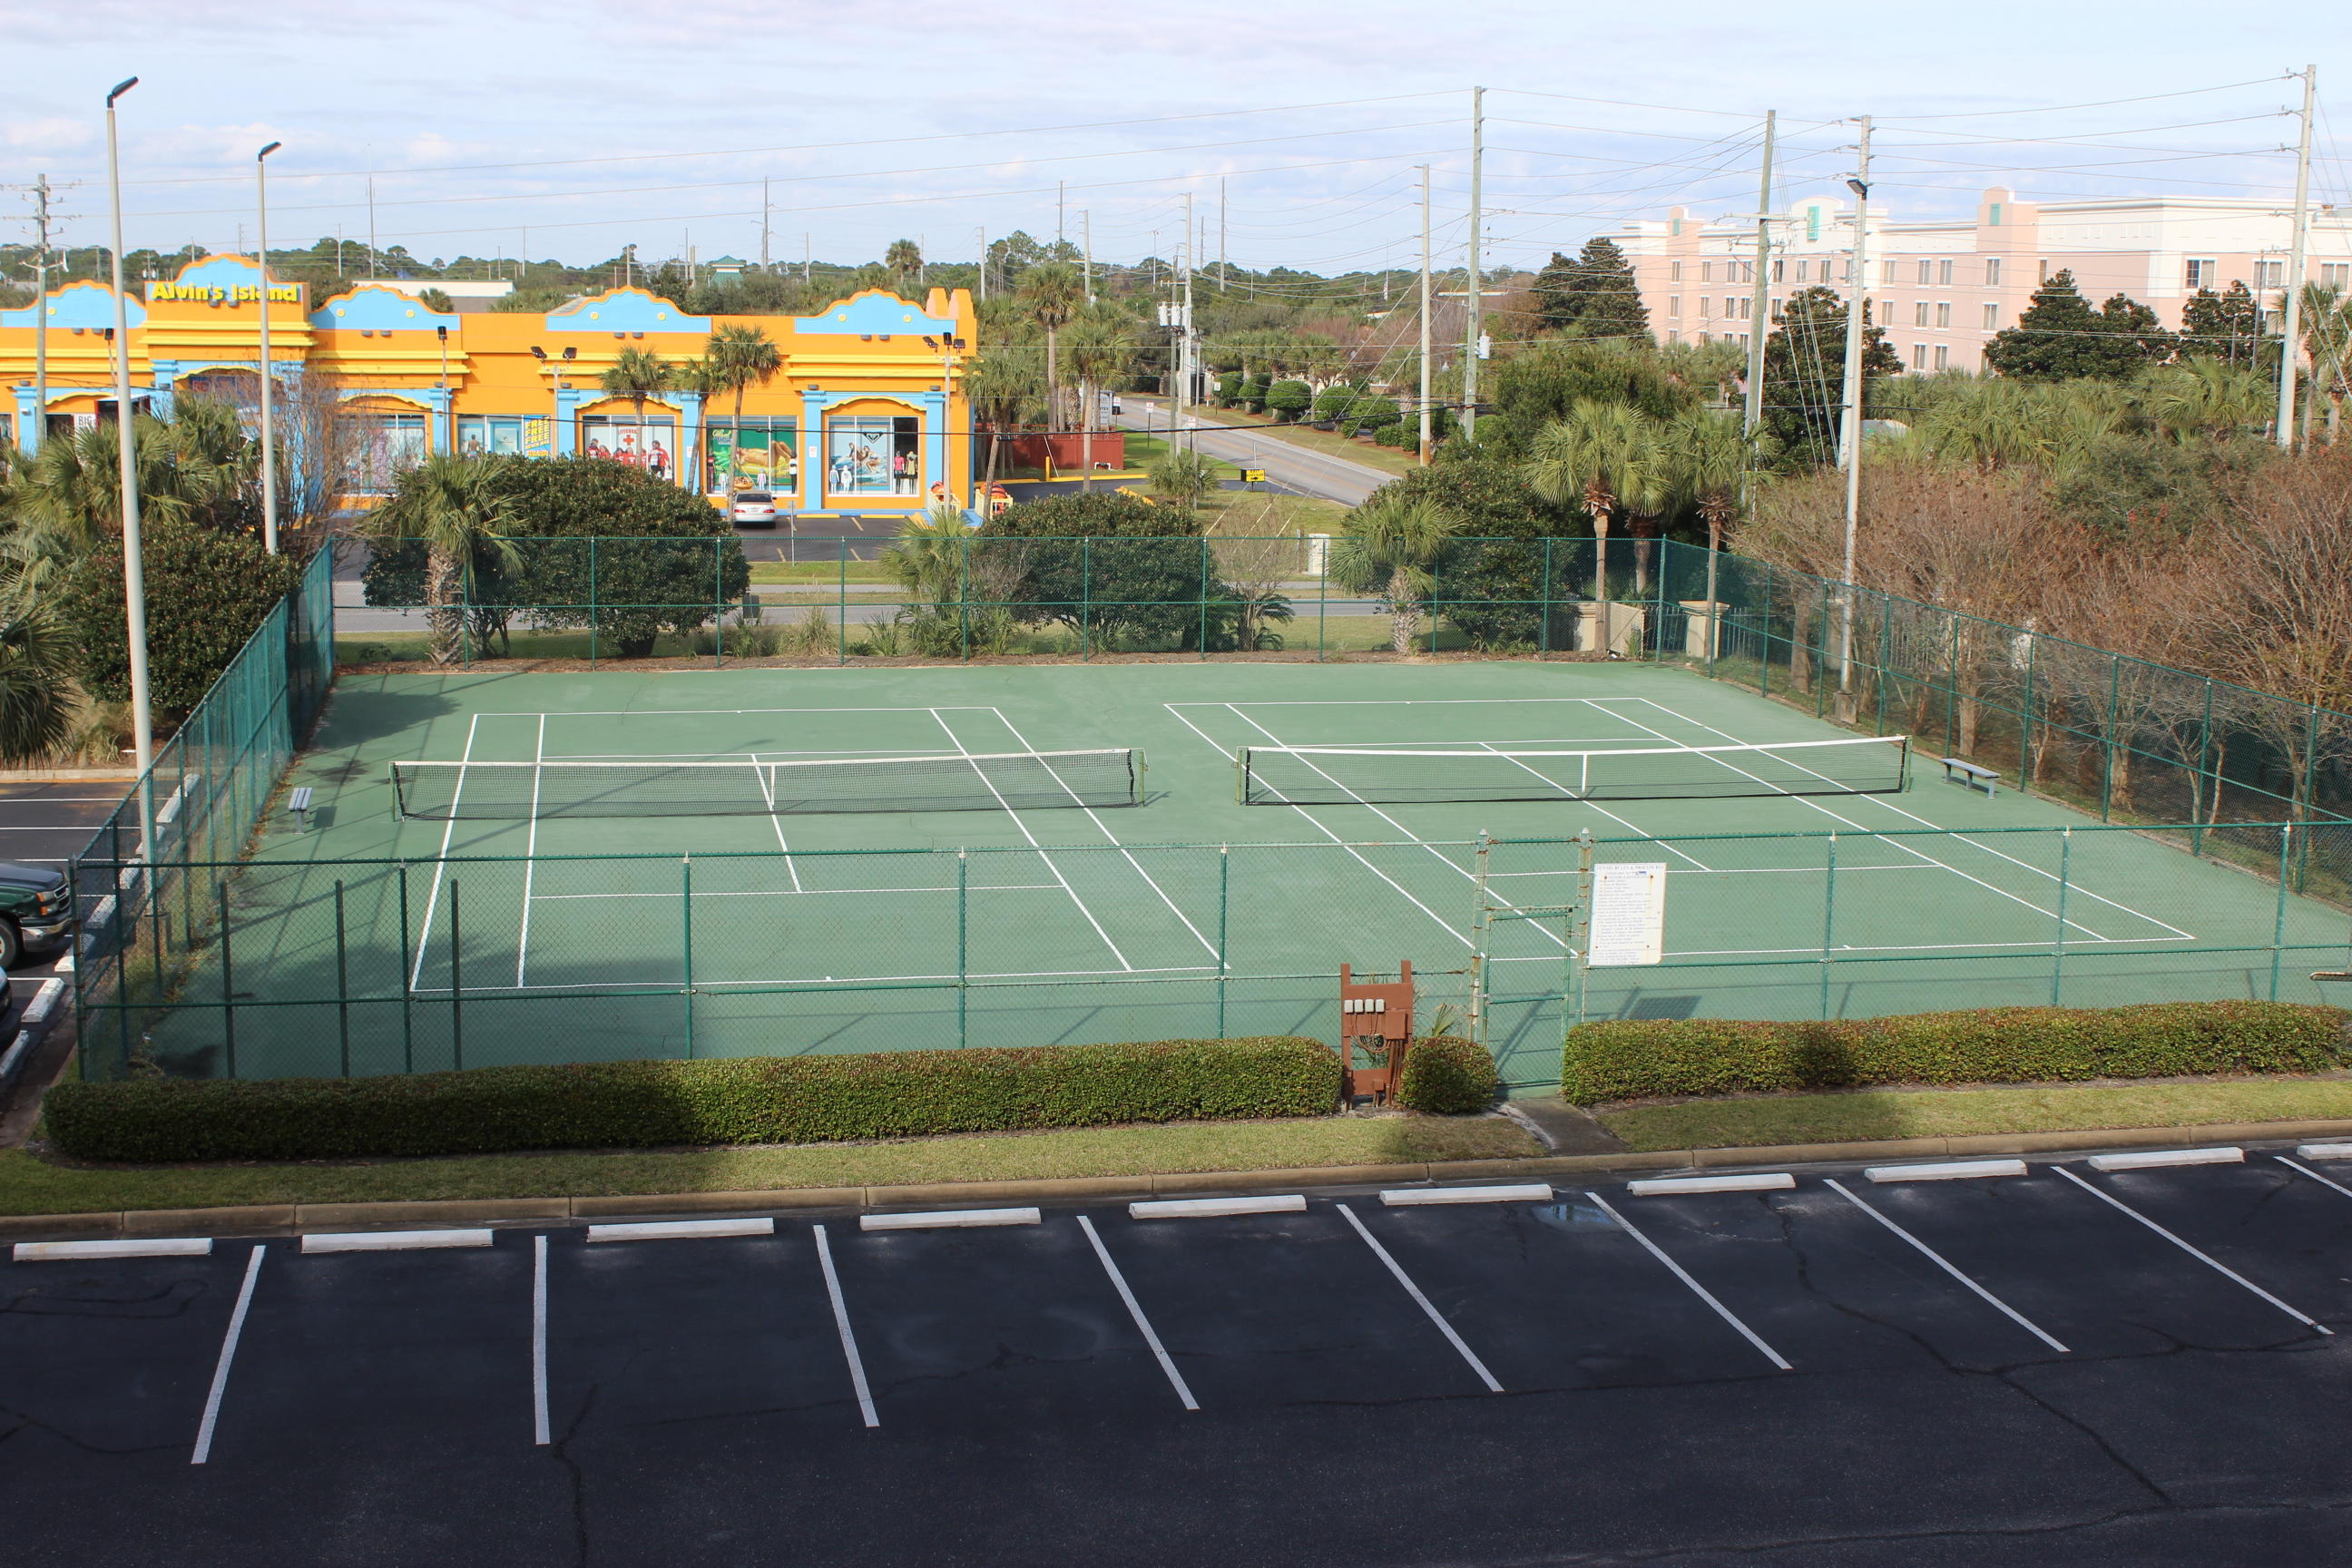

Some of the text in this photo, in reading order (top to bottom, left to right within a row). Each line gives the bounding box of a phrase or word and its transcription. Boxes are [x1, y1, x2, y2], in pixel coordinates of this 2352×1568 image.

[152, 282, 223, 300] Alvin's
[525, 416, 550, 429] FREE
[525, 424, 550, 436] FREE
[525, 431, 550, 444] FREE
